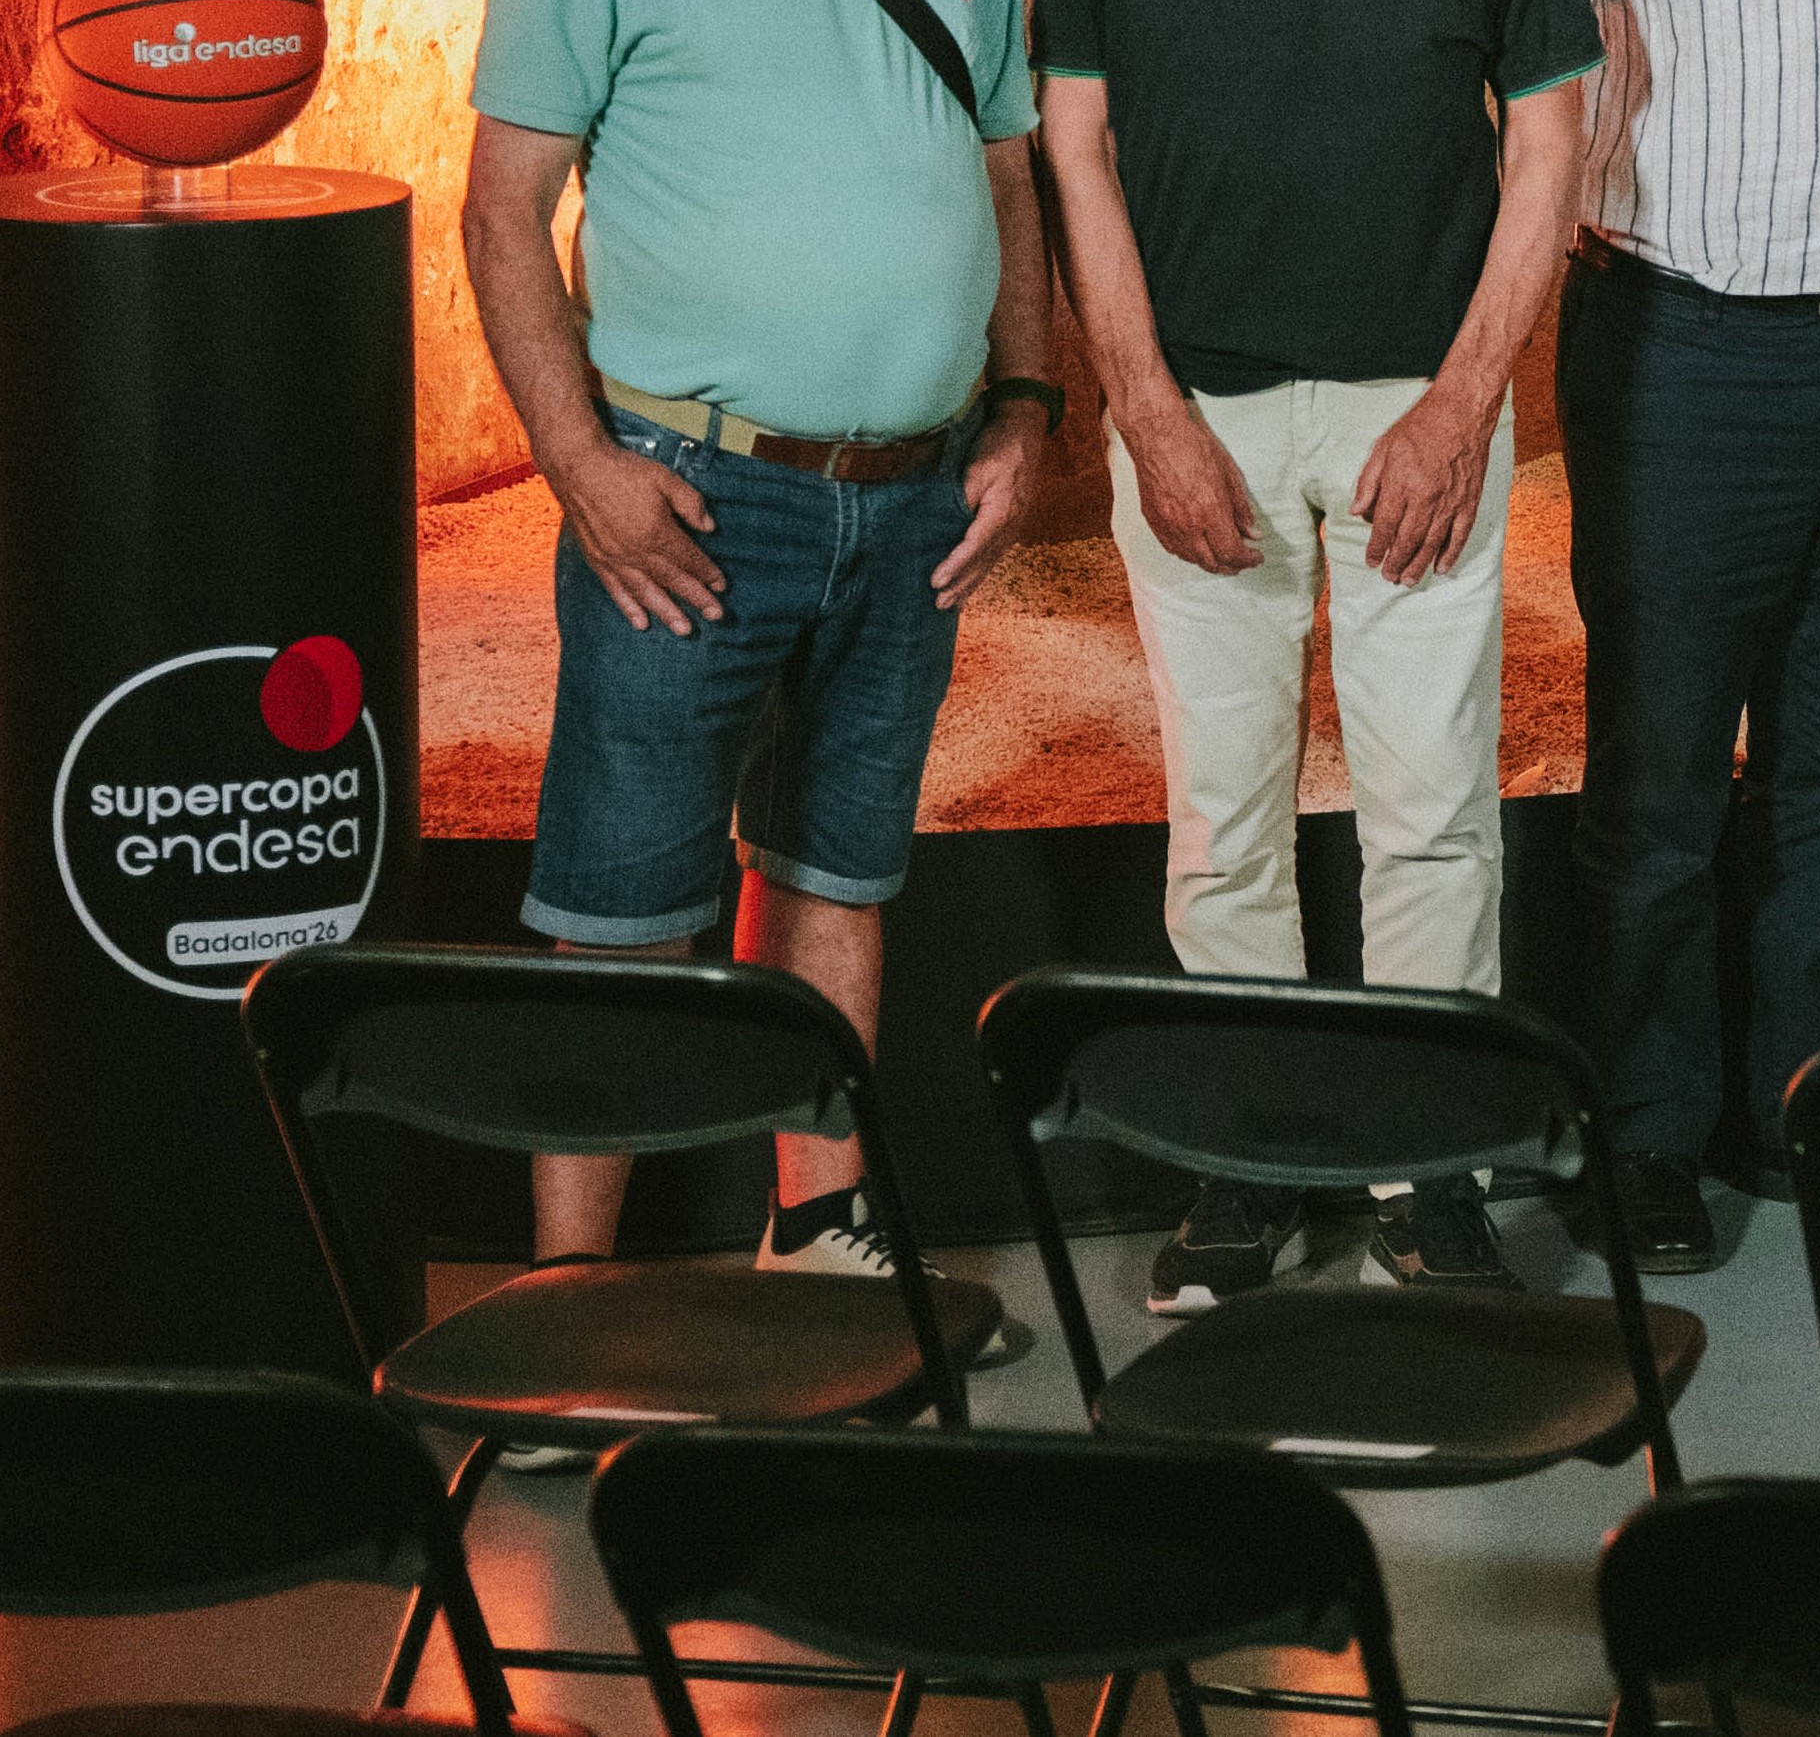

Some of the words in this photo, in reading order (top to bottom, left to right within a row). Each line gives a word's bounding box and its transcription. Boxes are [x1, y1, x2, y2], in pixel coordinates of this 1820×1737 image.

[133, 39, 190, 67] liga
[195, 35, 300, 61] endesa
[90, 768, 360, 824] supercopa
[116, 817, 359, 877] endesa
